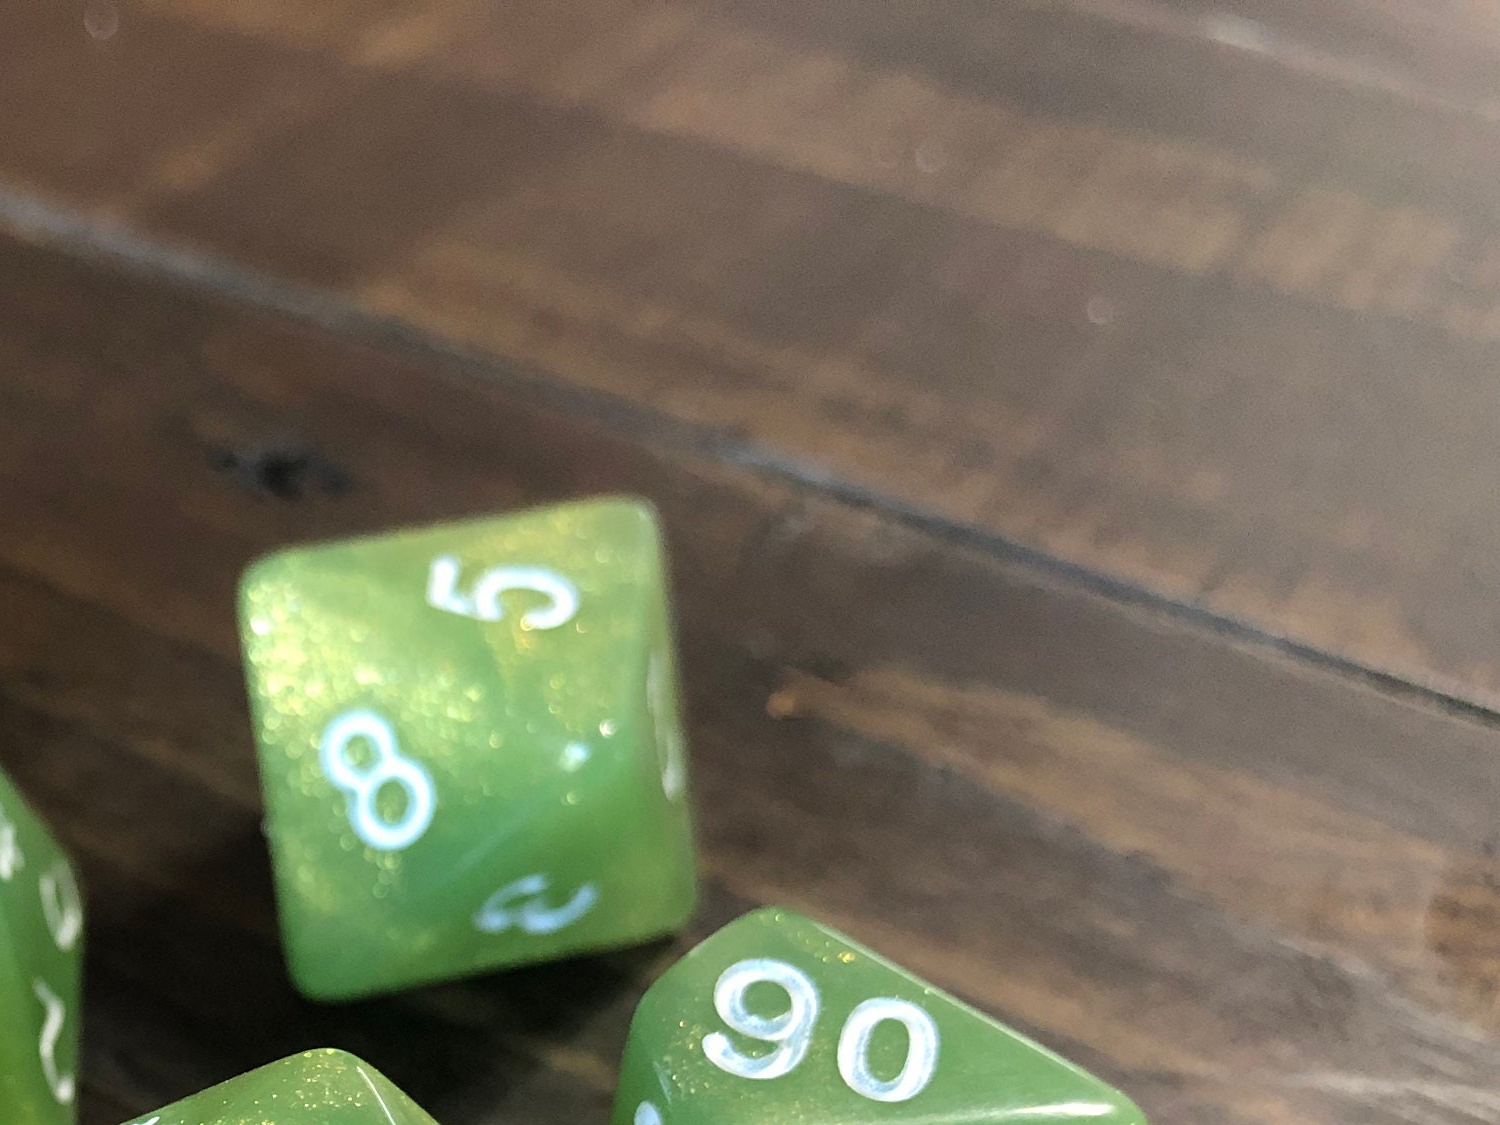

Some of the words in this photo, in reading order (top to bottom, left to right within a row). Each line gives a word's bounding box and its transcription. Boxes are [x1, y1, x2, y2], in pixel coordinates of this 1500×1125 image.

[425, 554, 580, 630] 5
[319, 707, 437, 850] 8
[702, 958, 940, 1103] 90
